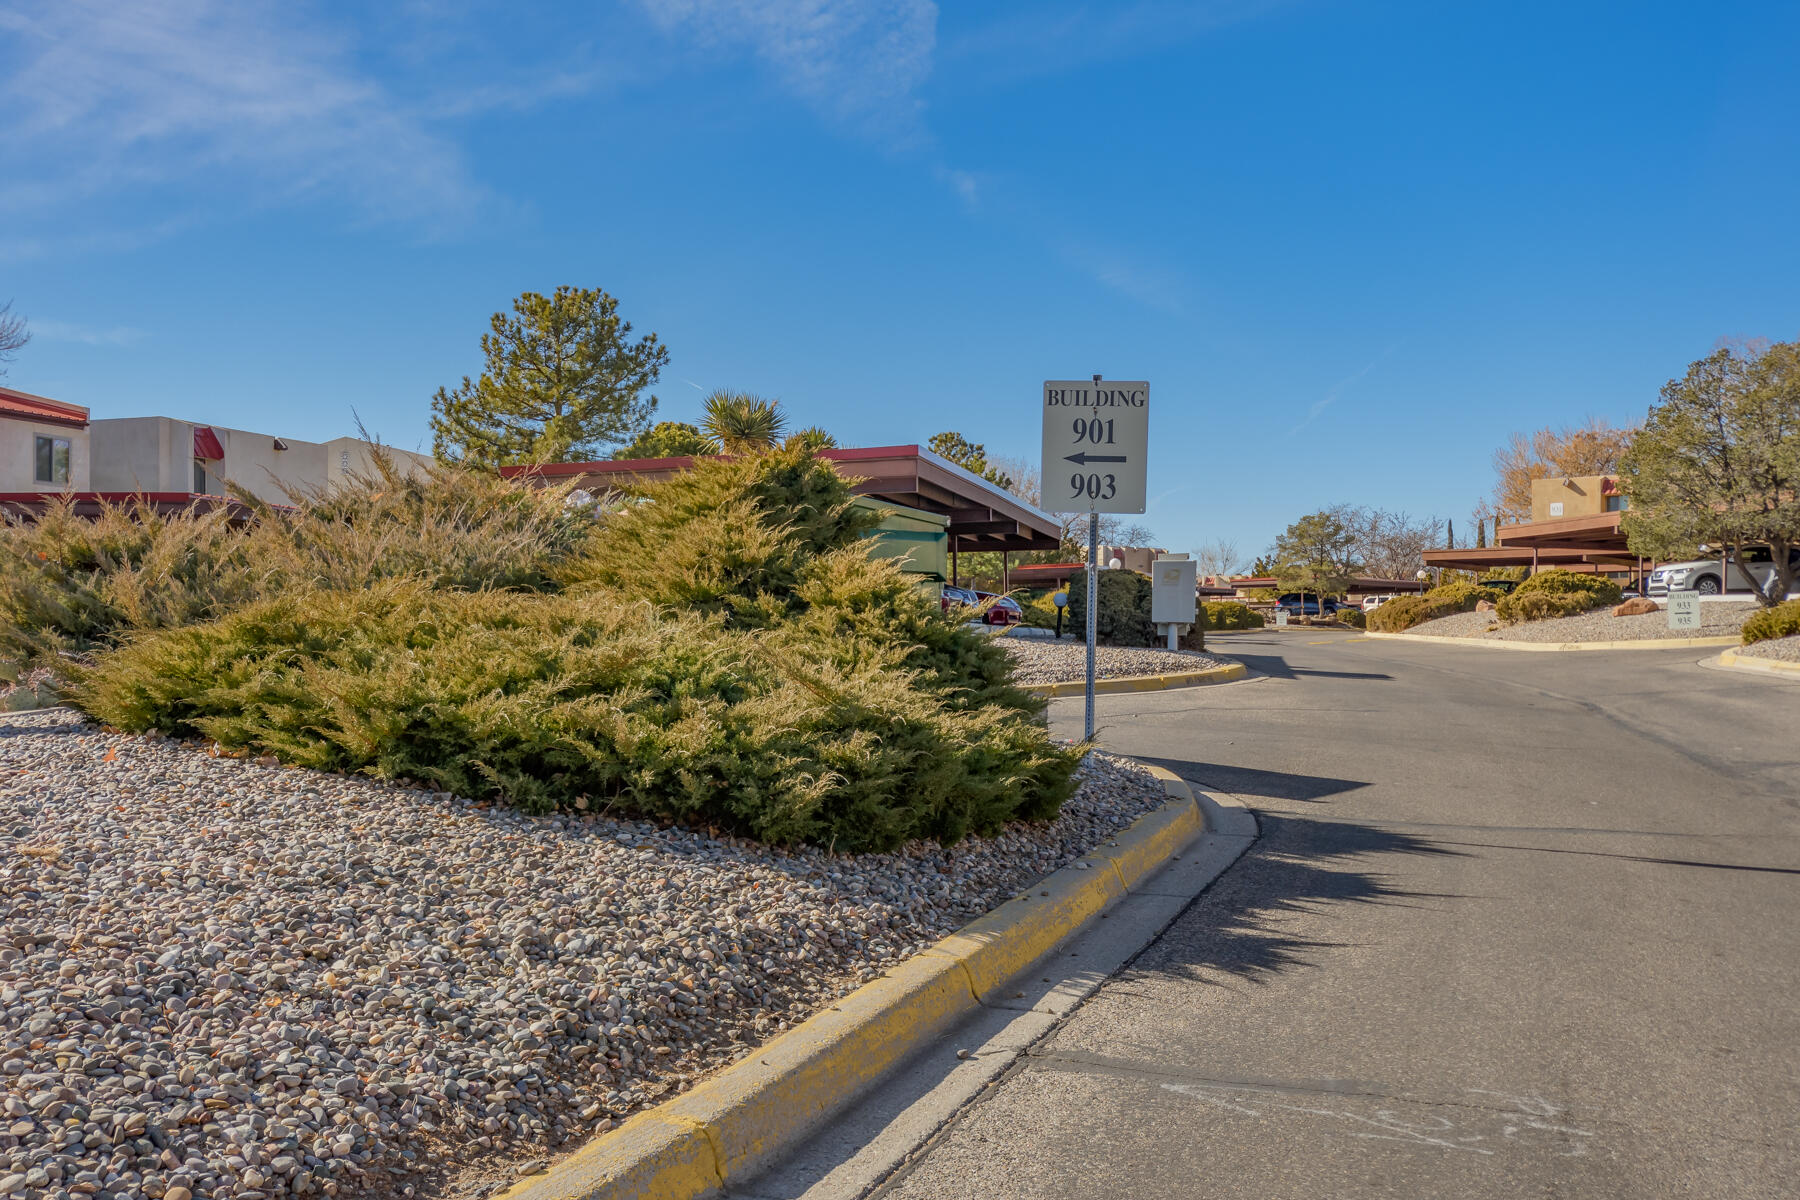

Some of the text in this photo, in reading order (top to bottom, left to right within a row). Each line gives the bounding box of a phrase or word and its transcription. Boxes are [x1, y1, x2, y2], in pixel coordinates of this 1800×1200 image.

[1047, 389, 1145, 408] BUILDING
[1072, 417, 1117, 445] 901
[1069, 473, 1117, 500] 903
